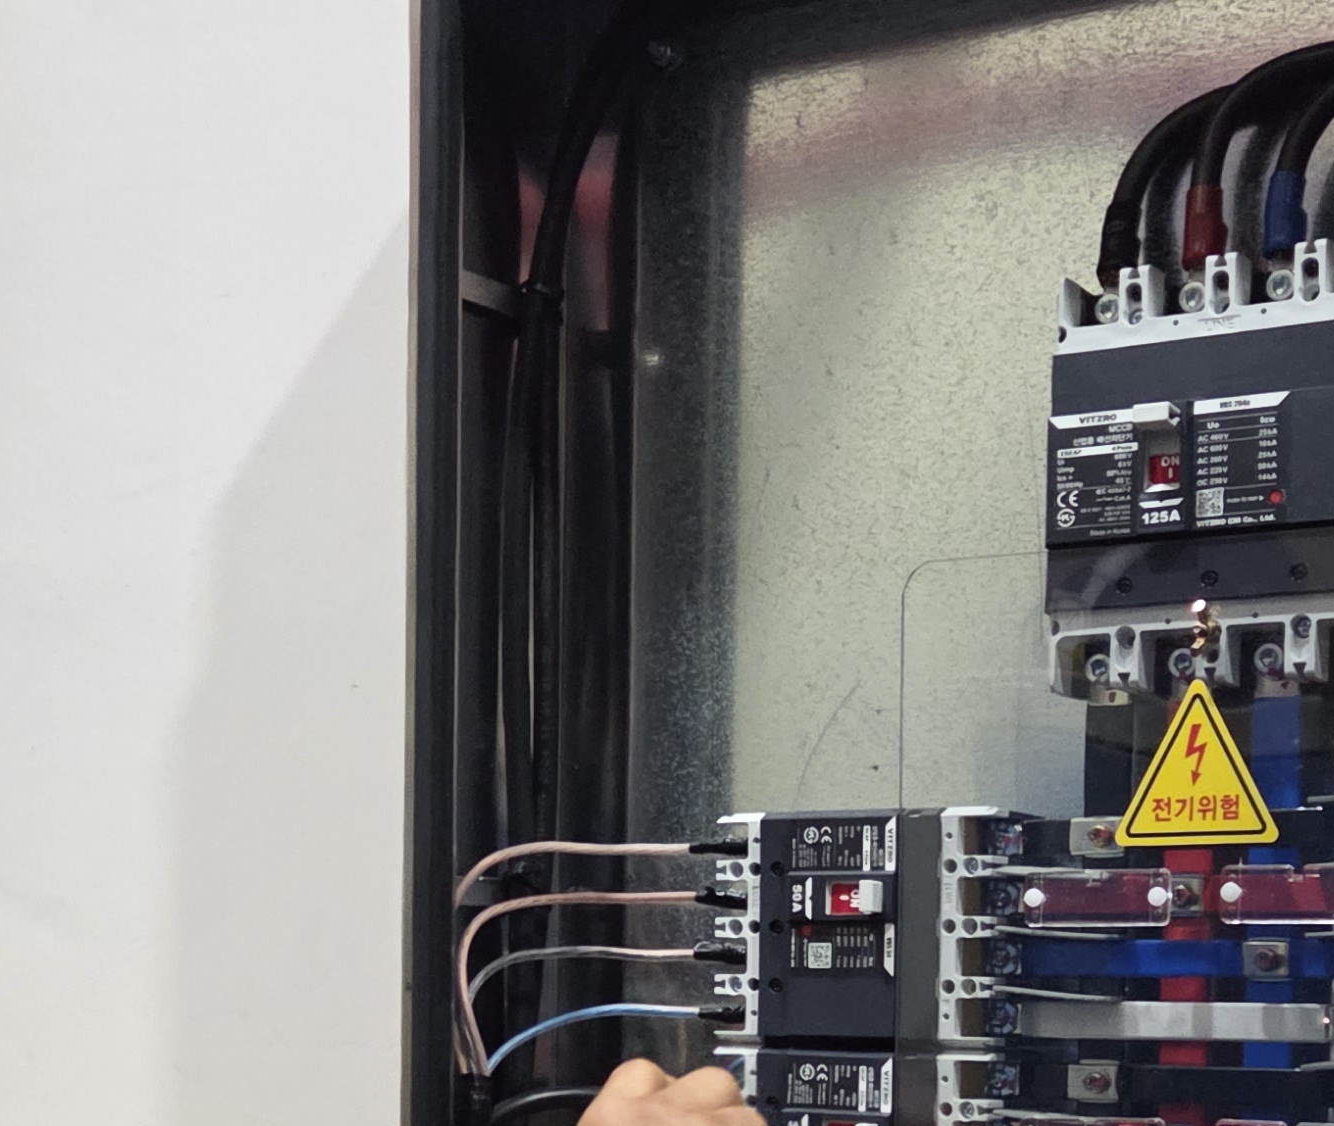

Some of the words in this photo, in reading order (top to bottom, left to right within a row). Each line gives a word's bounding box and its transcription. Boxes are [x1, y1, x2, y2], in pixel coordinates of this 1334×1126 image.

[1079, 413, 1117, 424] VITZRO
[1161, 456, 1180, 467] ON
[1142, 509, 1181, 525] 125A
[1151, 794, 1240, 823] 전기위험
[886, 827, 894, 864] VITZRO
[792, 884, 803, 913] 50A
[882, 1070, 891, 1106] VITZRO
